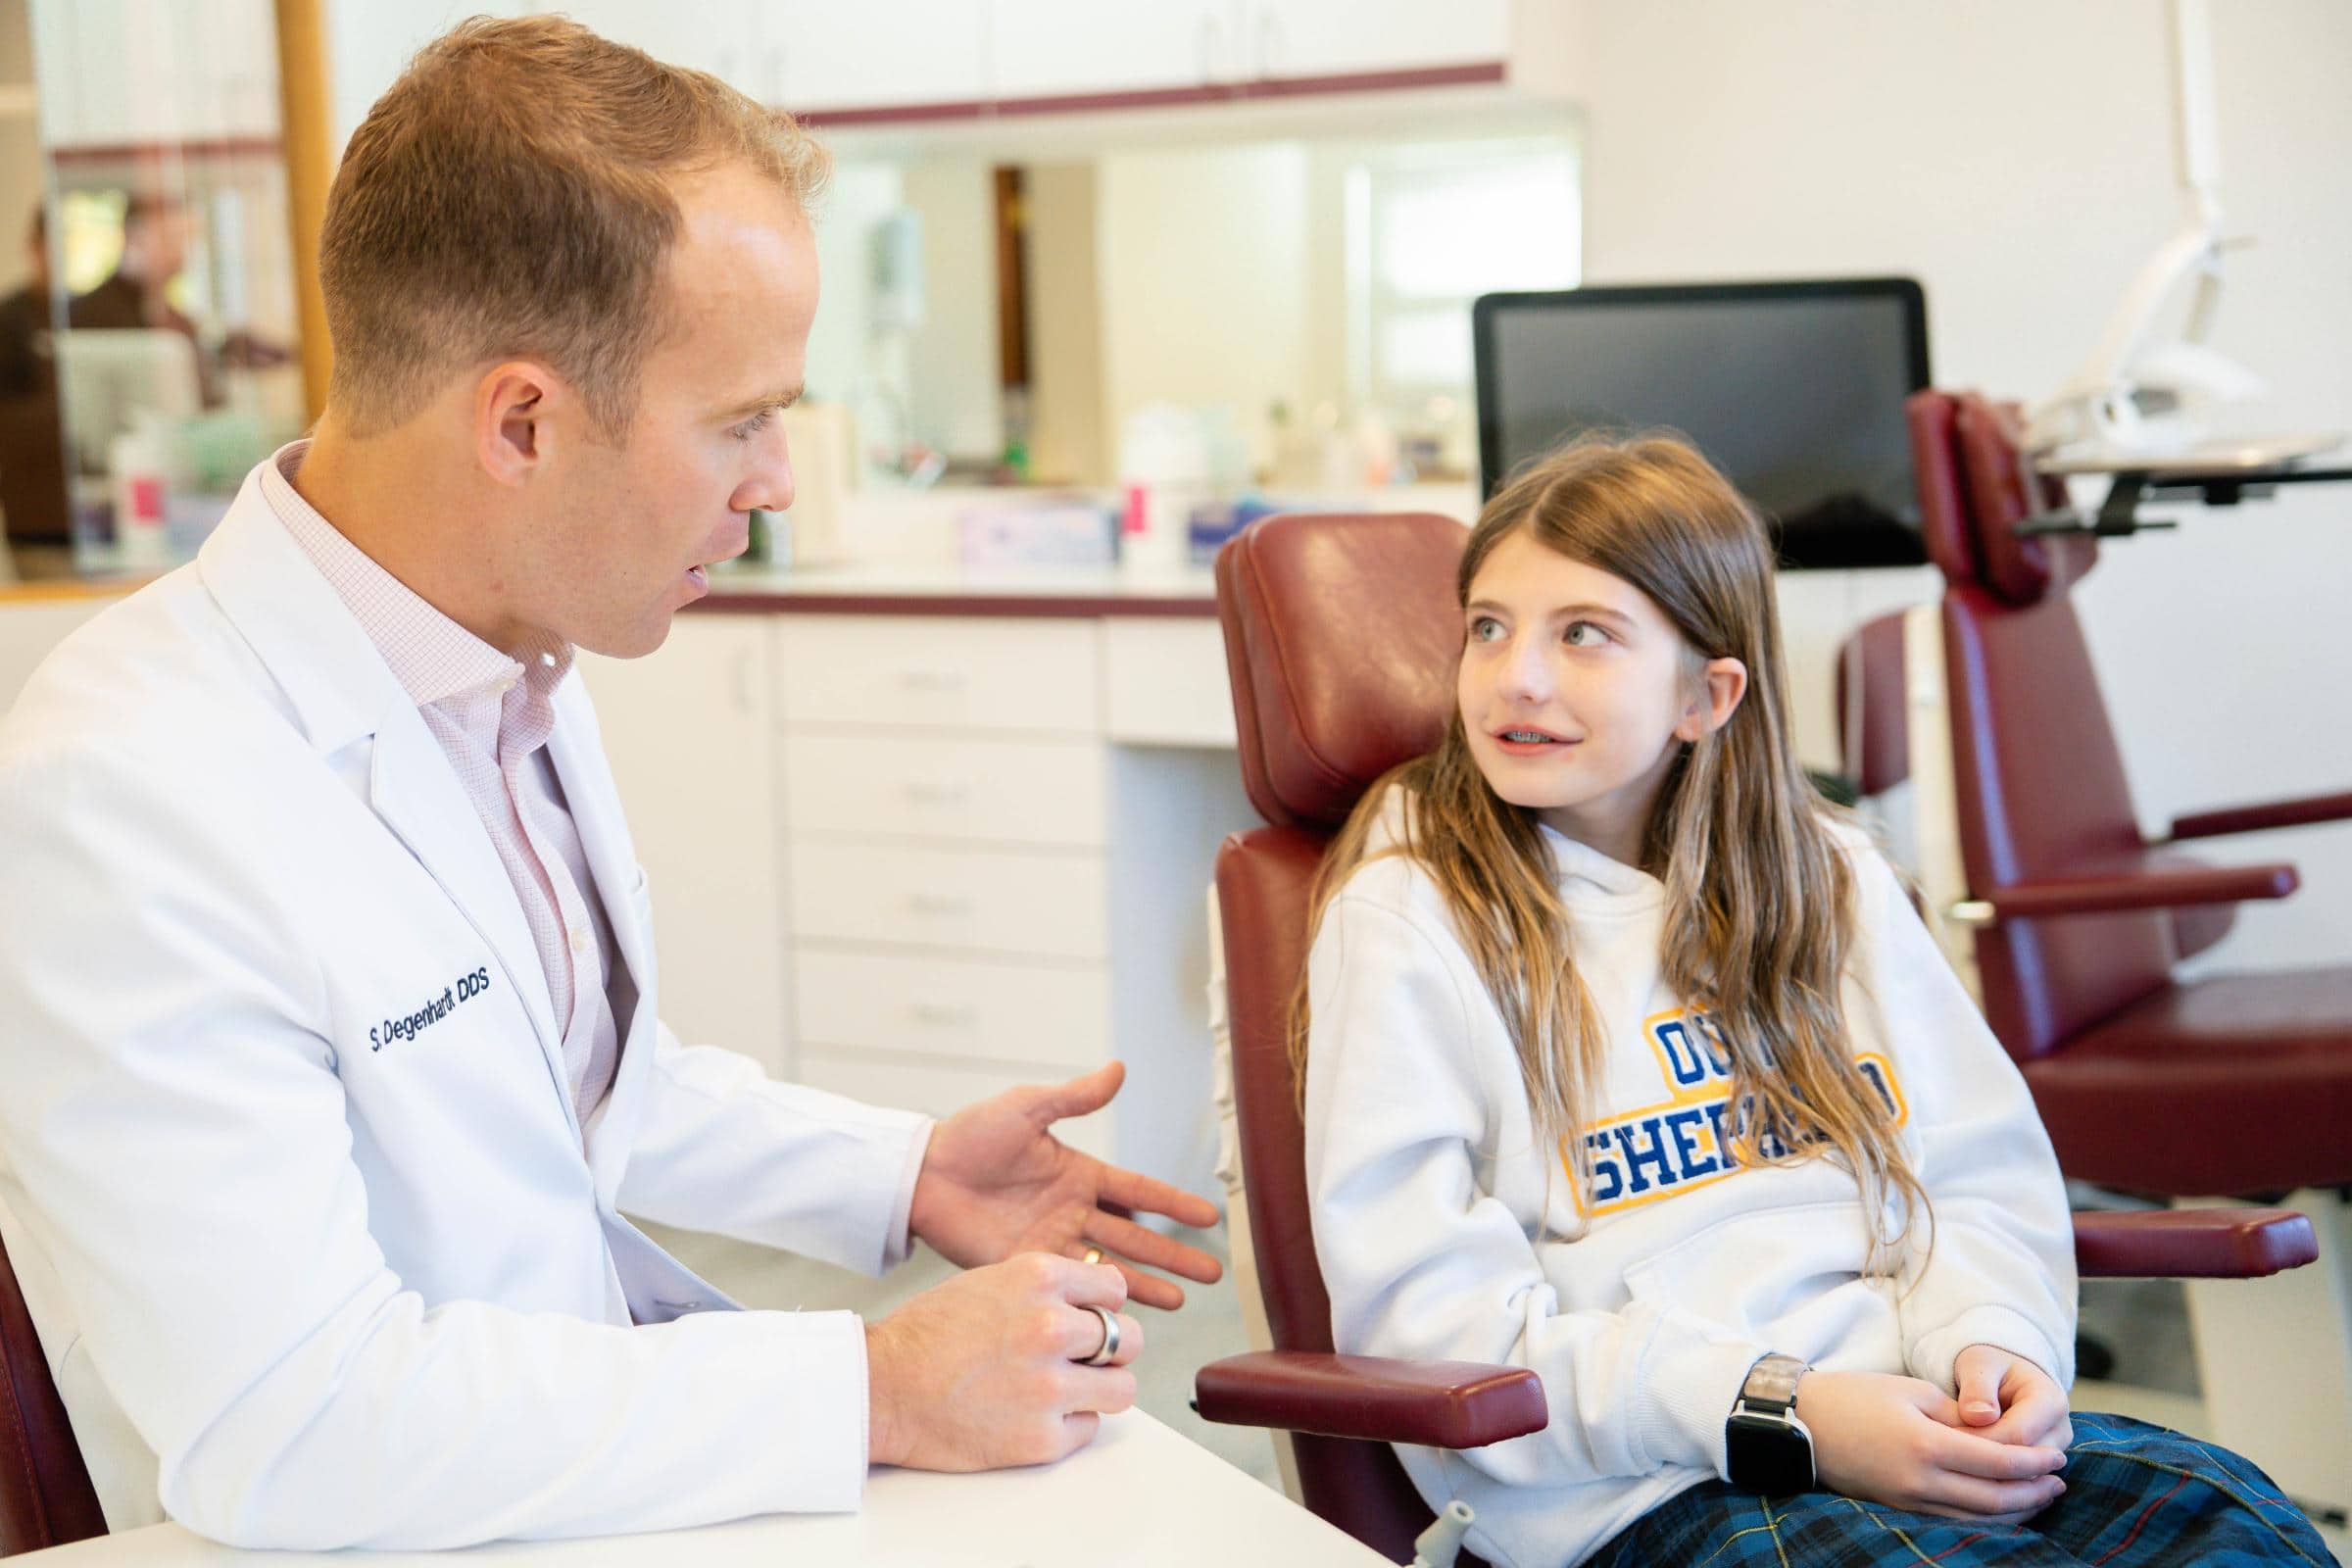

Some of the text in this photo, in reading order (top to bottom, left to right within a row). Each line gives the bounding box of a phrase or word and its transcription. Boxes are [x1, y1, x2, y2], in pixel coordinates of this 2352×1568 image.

[383, 986, 456, 1045] Degenhardt
[457, 966, 490, 1004] DDS
[1655, 1014, 1772, 1085] OU
